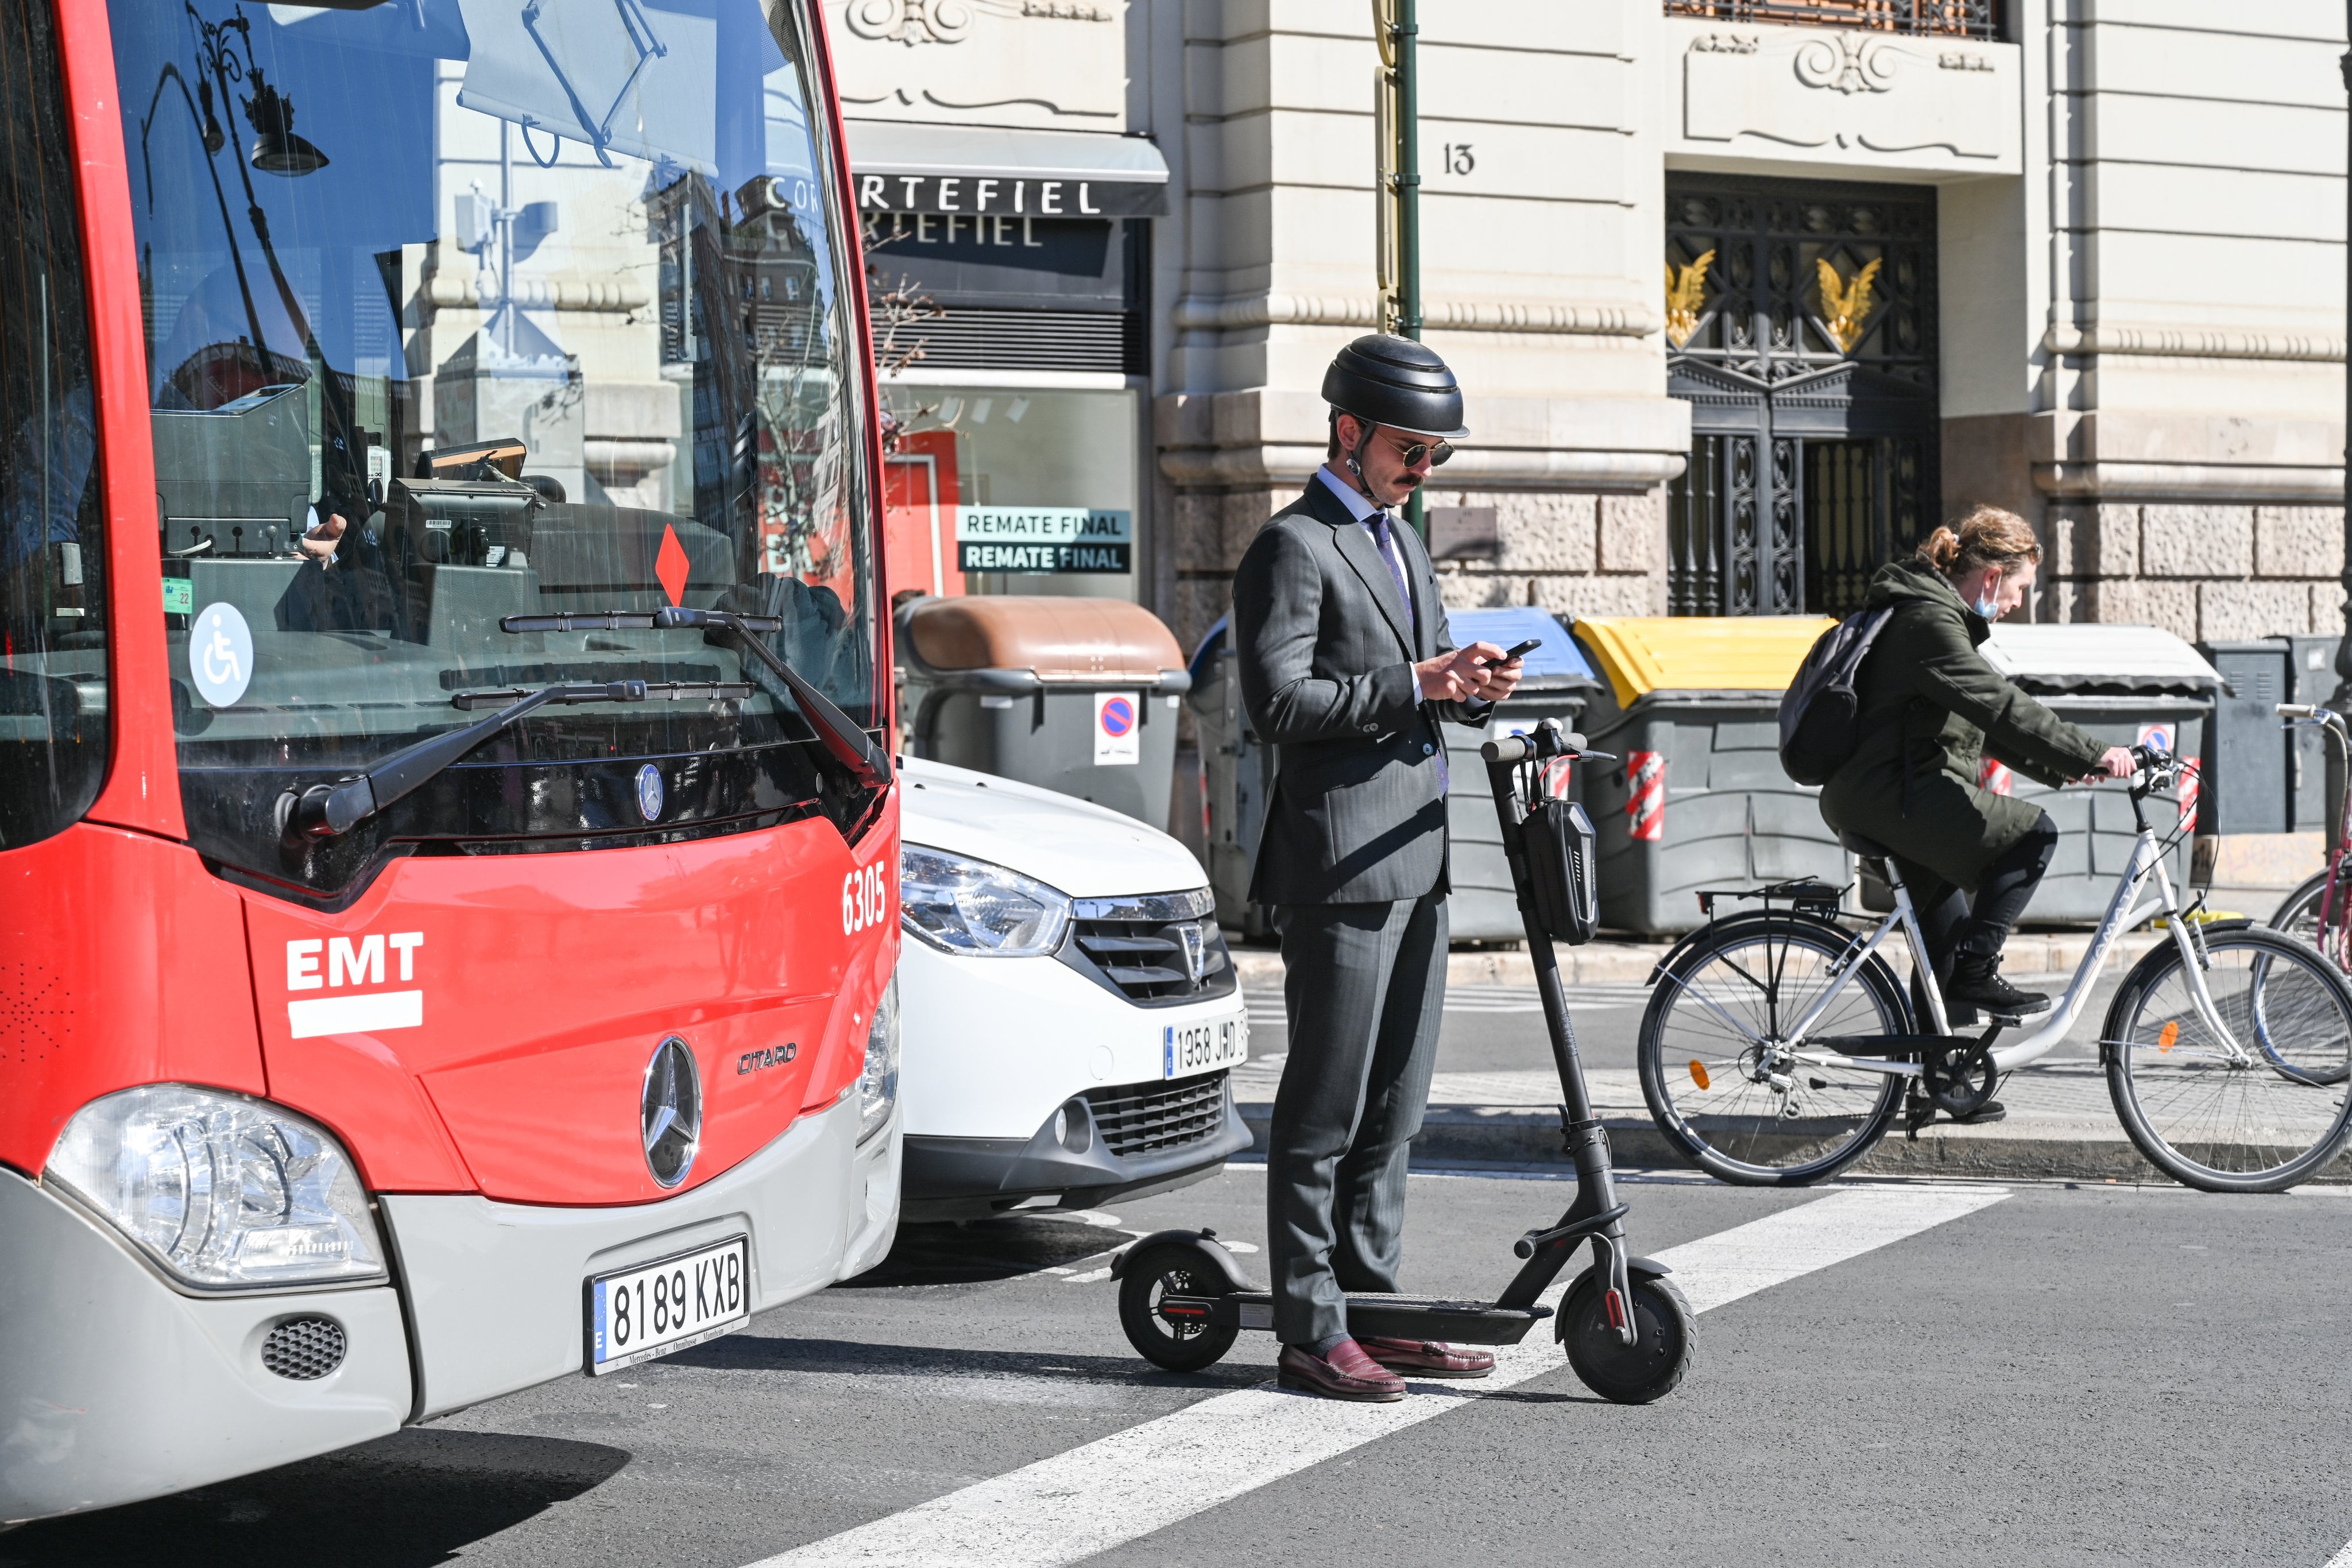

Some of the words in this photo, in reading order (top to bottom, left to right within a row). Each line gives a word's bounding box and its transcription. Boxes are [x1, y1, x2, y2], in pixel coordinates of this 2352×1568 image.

[1444, 142, 1475, 176] 13
[968, 515, 1052, 534] REMATE
[1062, 516, 1122, 536] FINAL
[965, 545, 1055, 568] REMATE
[1059, 547, 1123, 569] FINAL
[180, 593, 189, 604] 22
[842, 860, 886, 936] 6305
[287, 931, 424, 991] EMT
[737, 1042, 796, 1075] CITARO
[1178, 1027, 1210, 1070] 1958
[614, 1269, 686, 1346] 8189
[695, 1252, 740, 1323] KXB
[595, 1331, 603, 1349] E
